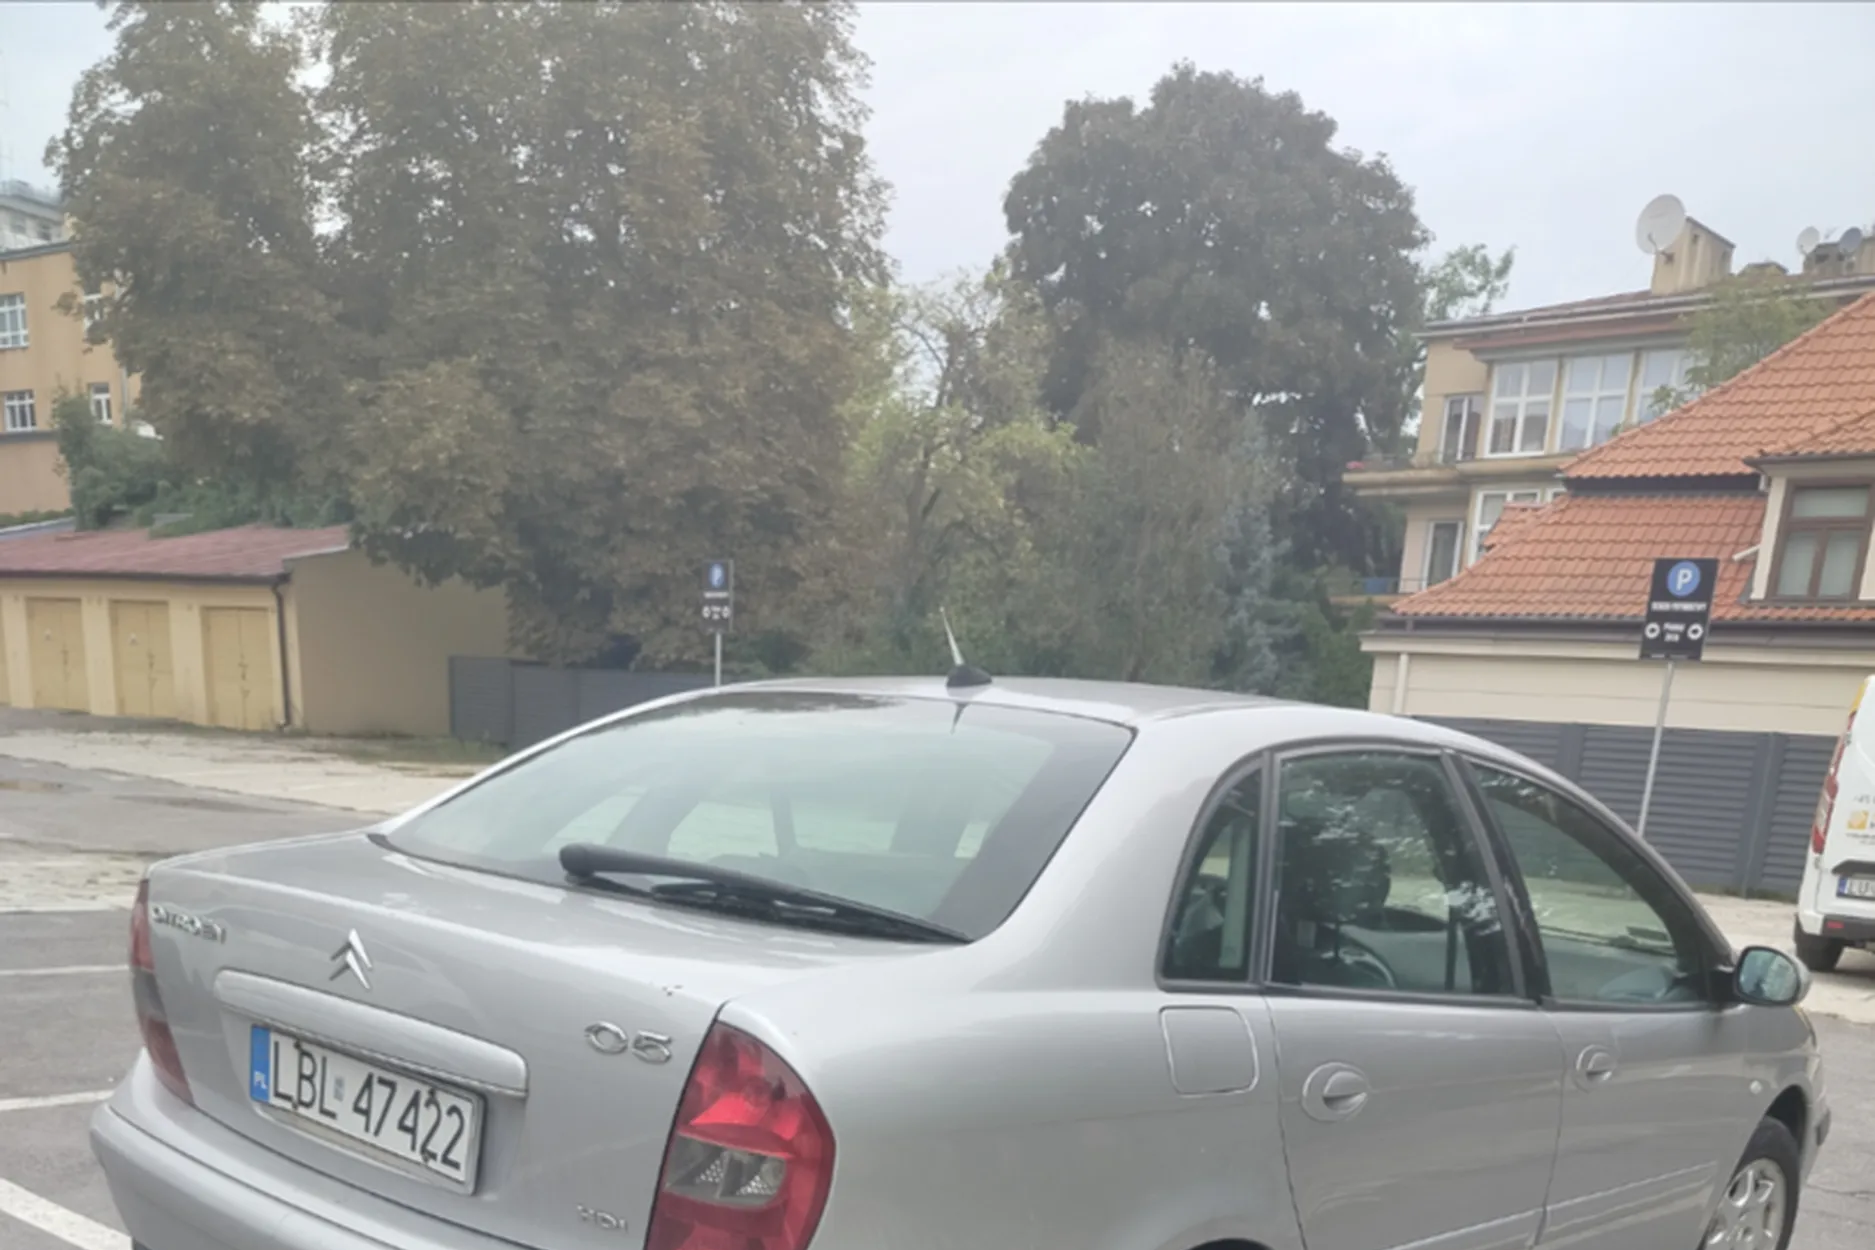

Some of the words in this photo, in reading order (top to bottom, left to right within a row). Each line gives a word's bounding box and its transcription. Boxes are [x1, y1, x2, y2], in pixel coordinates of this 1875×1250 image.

[1676, 568, 1693, 591] P
[272, 1040, 337, 1121] LBL
[352, 1071, 466, 1172] 47422
